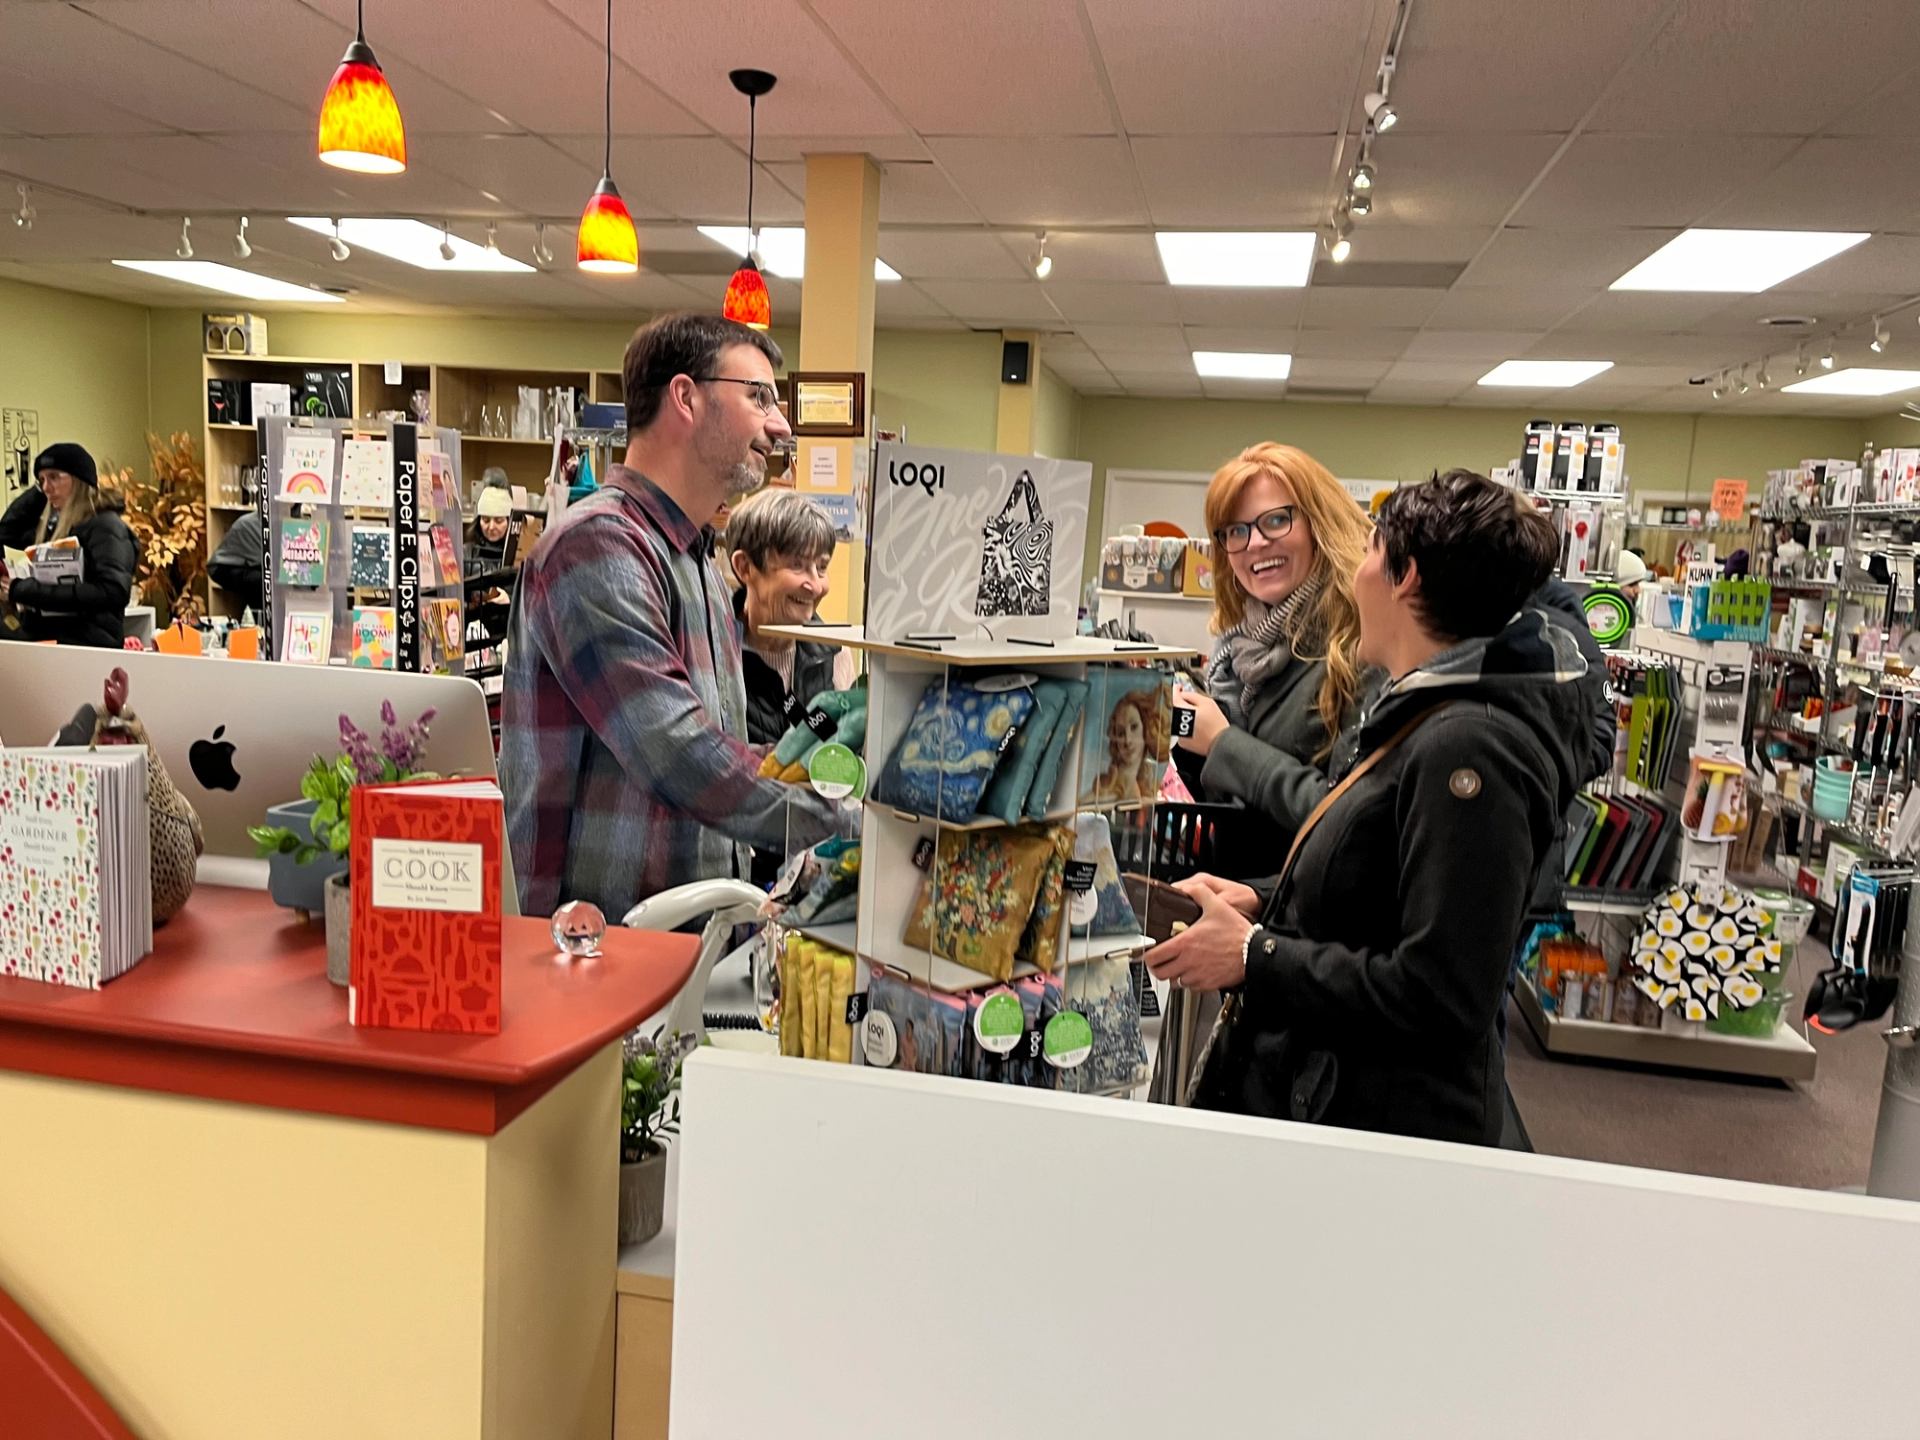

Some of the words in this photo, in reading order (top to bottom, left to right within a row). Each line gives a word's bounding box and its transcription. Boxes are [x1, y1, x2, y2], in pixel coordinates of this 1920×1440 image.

[889, 460, 945, 497] LOQI
[396, 461, 416, 529] Paper
[400, 533, 417, 552] E.
[282, 549, 321, 562] MILLION
[398, 557, 418, 611] Clips
[1688, 567, 1713, 582] KUHN
[808, 711, 828, 729] LOQI
[1179, 710, 1193, 736] LOQI
[10, 825, 68, 842] GARDENER
[383, 857, 471, 883] COOK
[867, 1021, 885, 1040] LOQI
